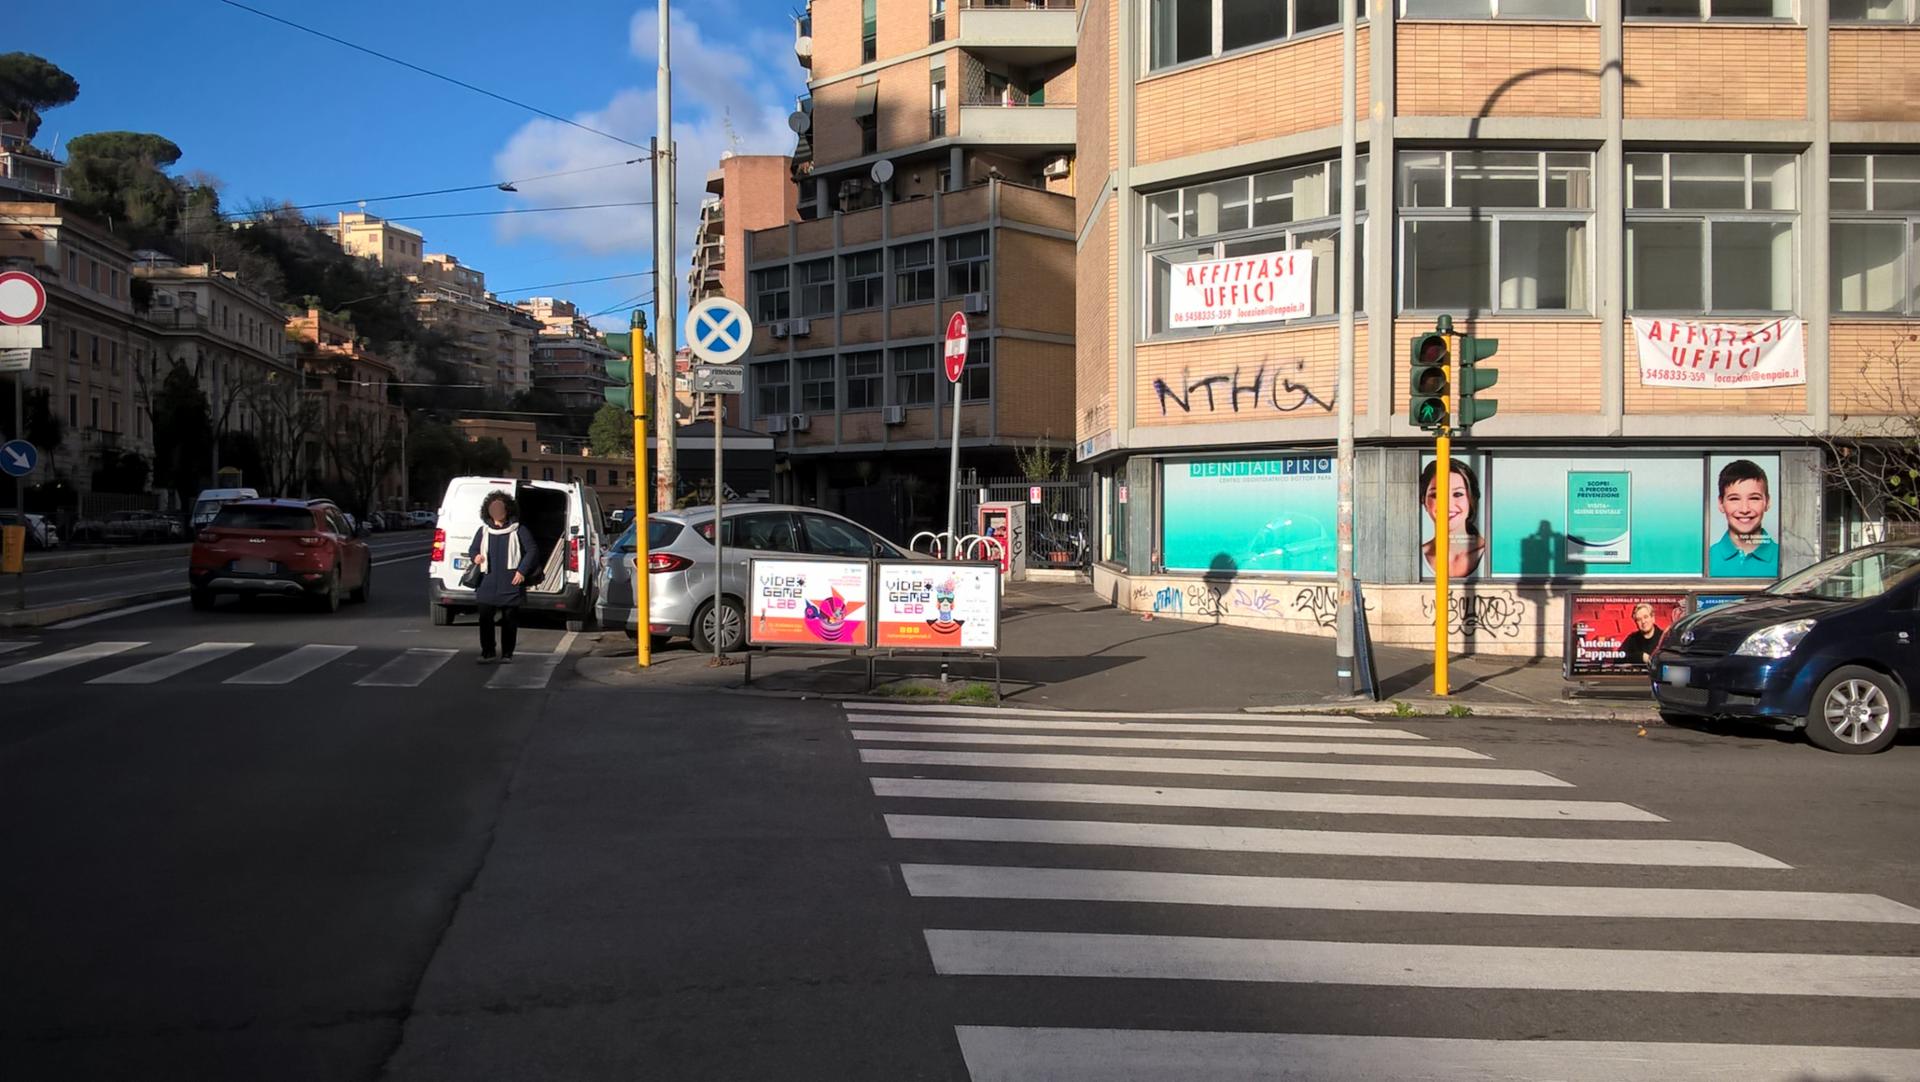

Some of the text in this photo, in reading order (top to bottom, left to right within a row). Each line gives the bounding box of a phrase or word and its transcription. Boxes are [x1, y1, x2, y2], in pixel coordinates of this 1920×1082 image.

[1186, 256, 1294, 286] AFFITTASI
[1204, 281, 1274, 307] UFFICI
[1174, 312, 1184, 323] 06
[1648, 320, 1781, 347] AFFITTASI
[1671, 346, 1761, 370] UFFICI
[1646, 368, 1706, 382] 5458335-359
[1713, 368, 1800, 384] locazioni@enpaia.it
[1577, 637, 1621, 648] Antonio
[1577, 648, 1626, 661] Pappano
